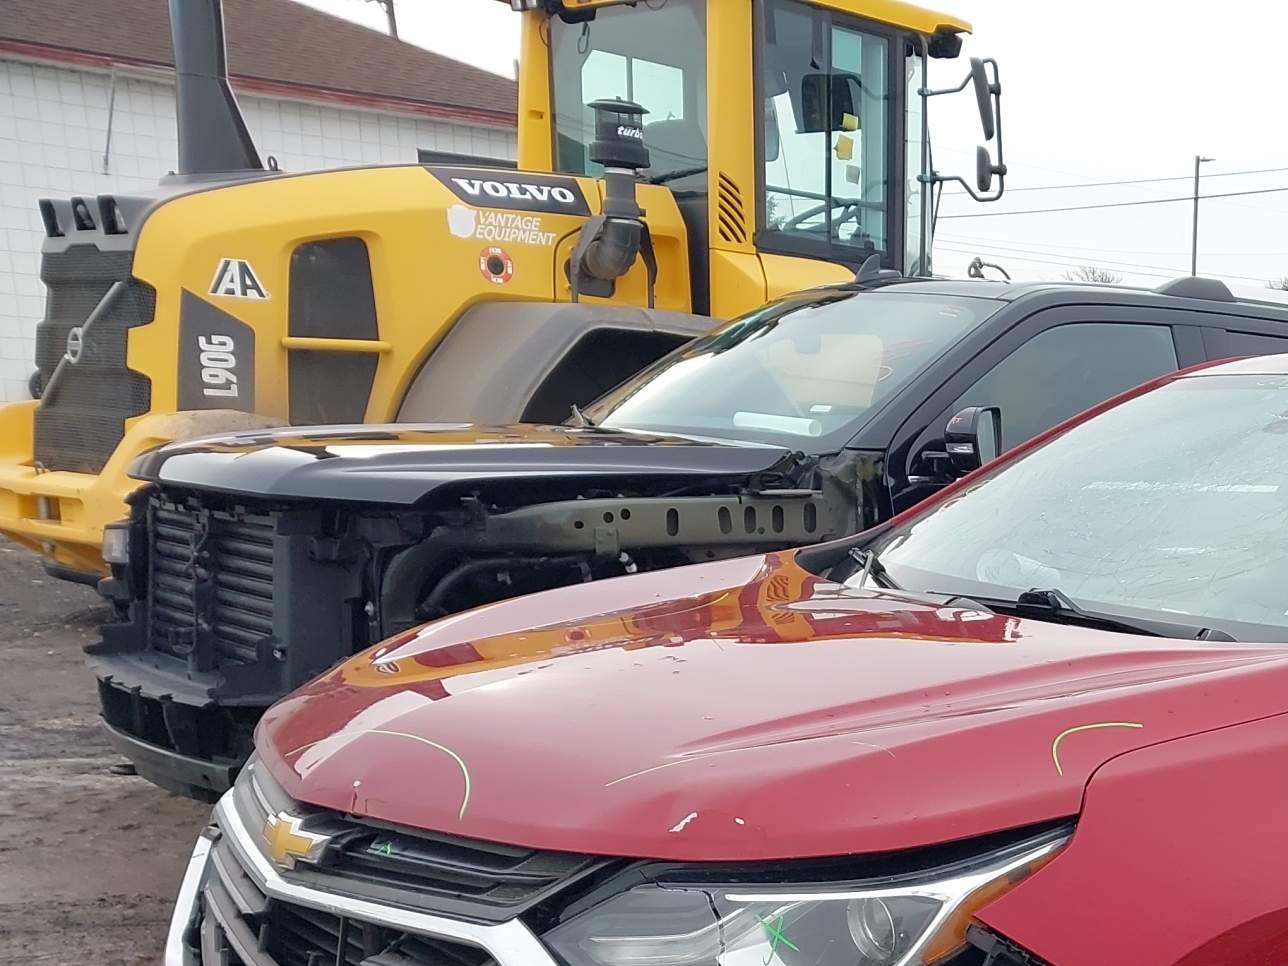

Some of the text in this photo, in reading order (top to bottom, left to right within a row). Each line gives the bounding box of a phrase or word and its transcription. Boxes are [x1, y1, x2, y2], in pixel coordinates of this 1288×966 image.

[451, 178, 575, 203] VOLVO
[477, 211, 541, 231] VANTAGE
[476, 225, 556, 246] EQUIPMENT
[198, 334, 238, 397] L90G
